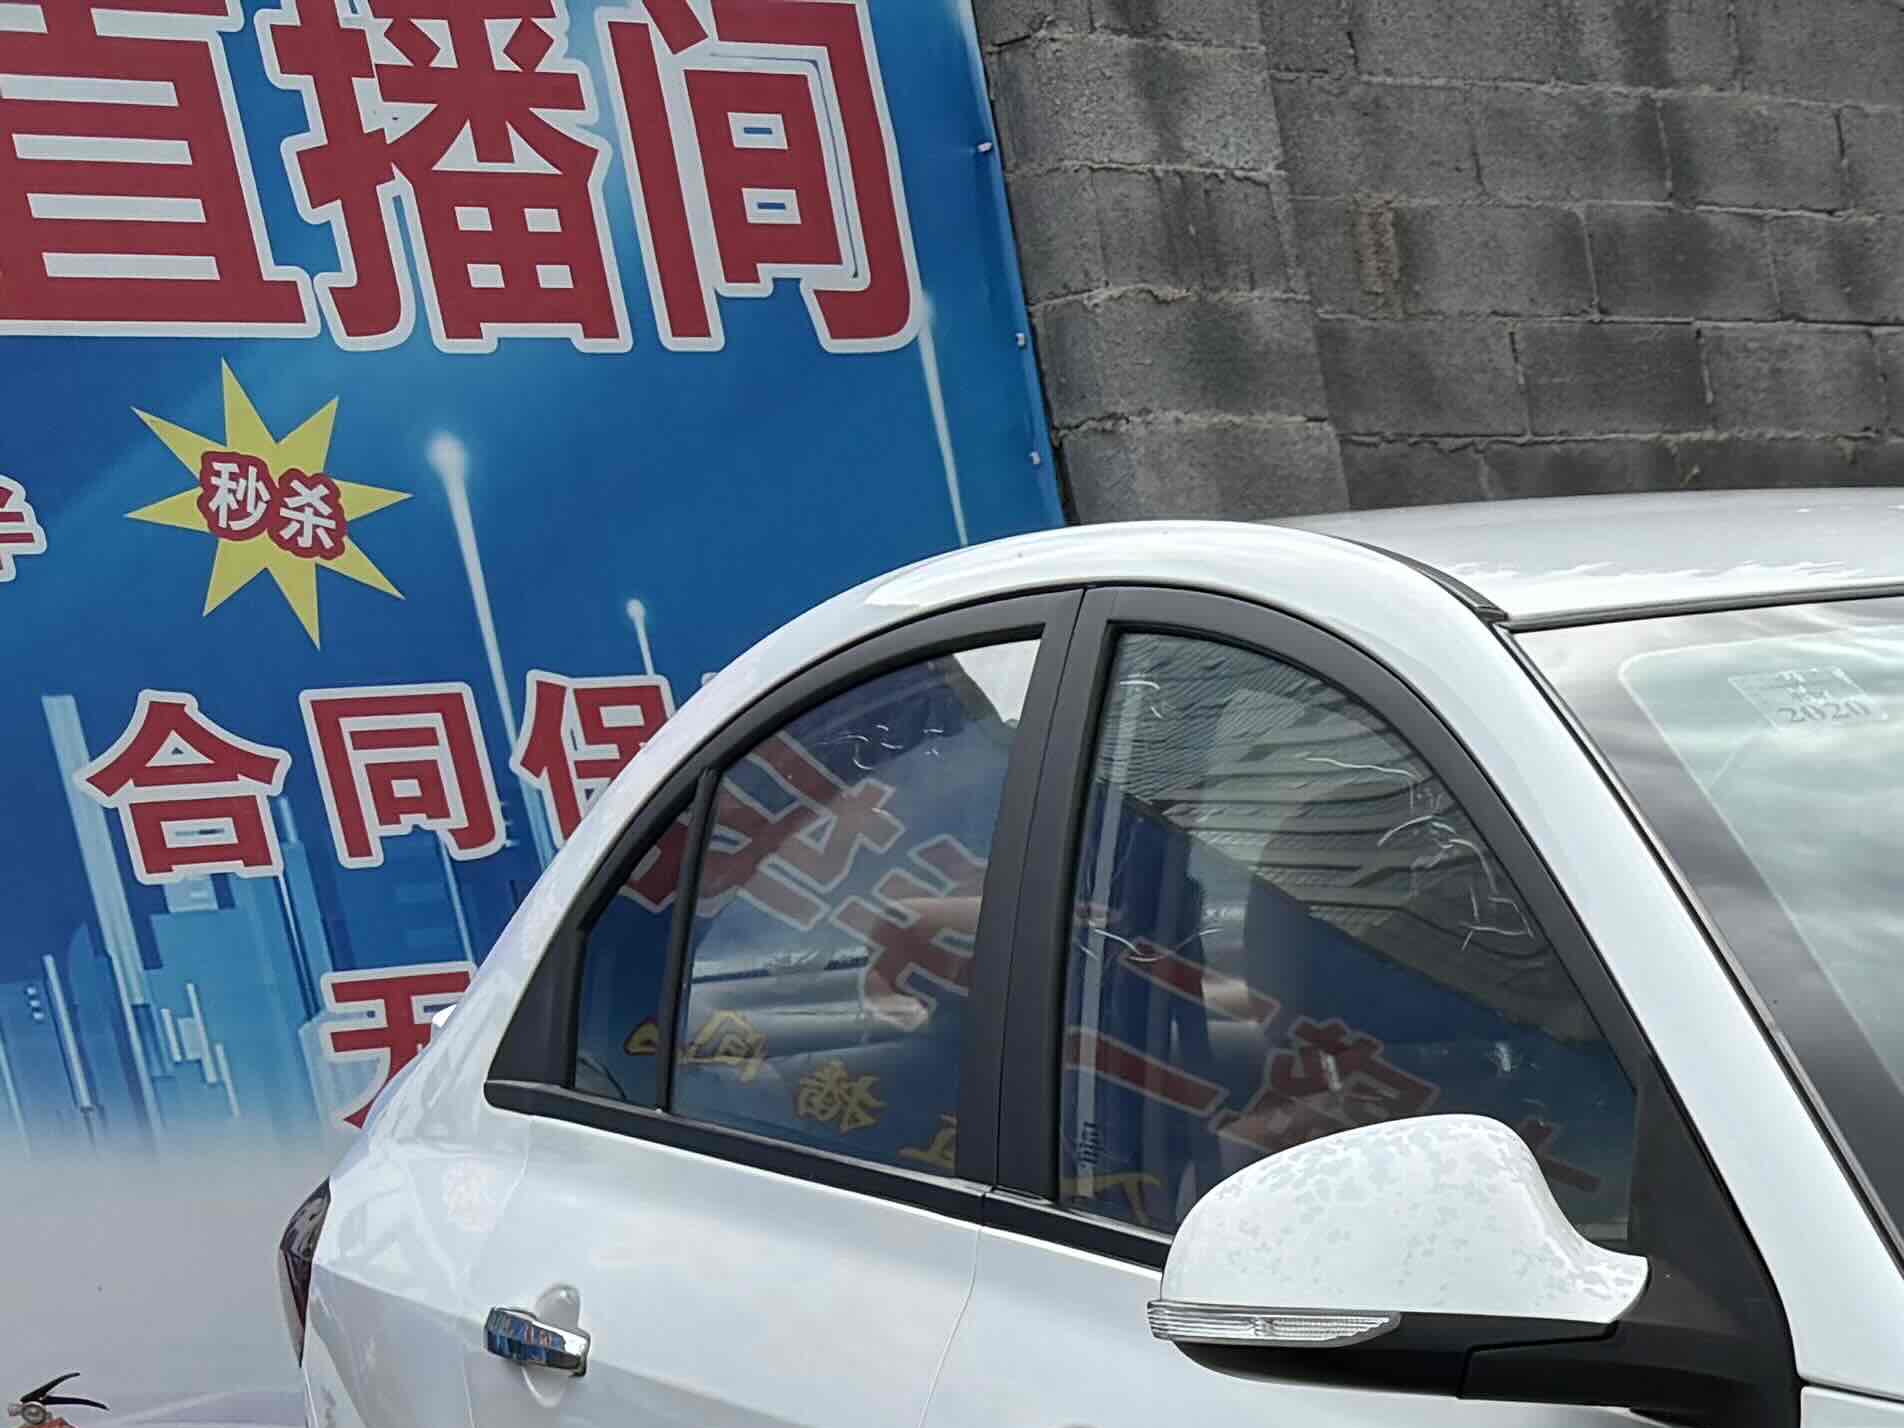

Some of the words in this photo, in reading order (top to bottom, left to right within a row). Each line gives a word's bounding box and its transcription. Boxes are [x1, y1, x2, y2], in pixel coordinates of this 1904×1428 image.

[0, 0, 922, 352] 直播间
[206, 458, 341, 553] 秒杀
[80, 669, 690, 882] 合同保
